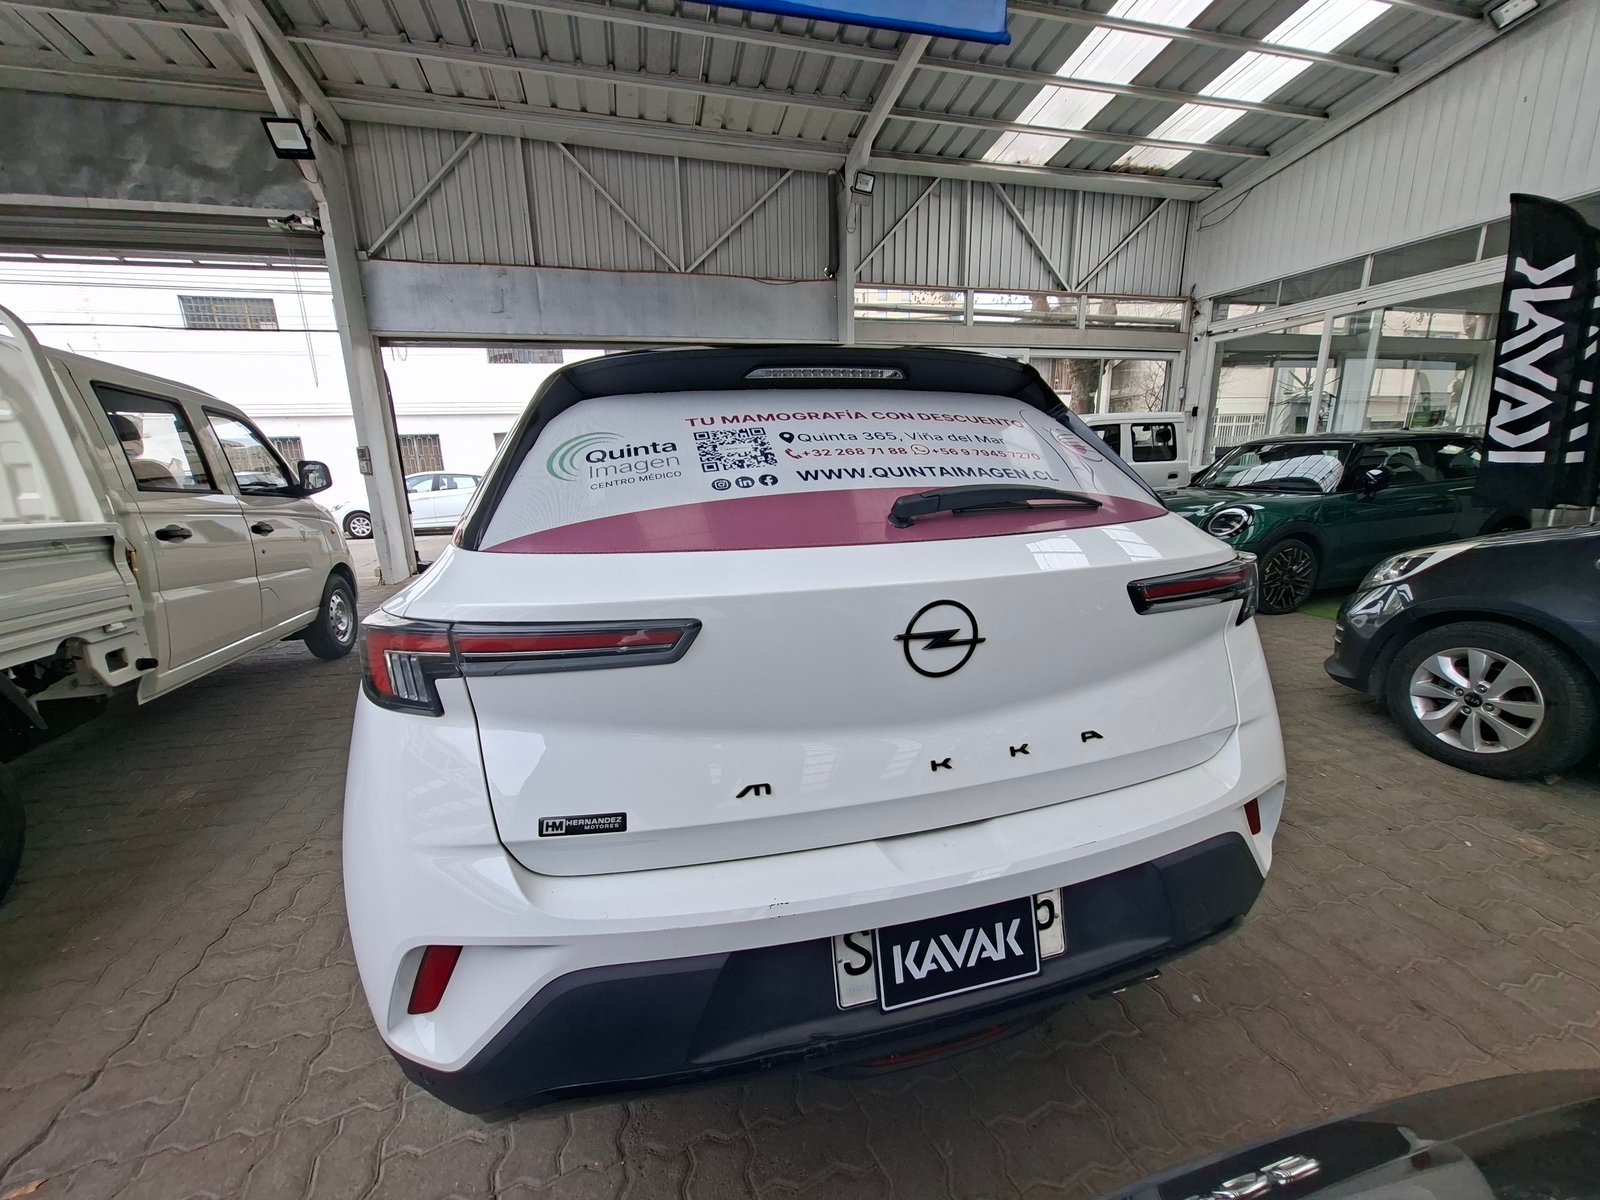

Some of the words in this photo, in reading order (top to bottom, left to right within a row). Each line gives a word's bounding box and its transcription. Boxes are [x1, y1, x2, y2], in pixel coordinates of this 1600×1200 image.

[685, 416, 716, 427] TU
[720, 409, 869, 425] MAMOGRAFÍA
[871, 411, 916, 421] CON
[916, 412, 1024, 428] DESCUENTO
[797, 432, 858, 443] Quinta
[862, 431, 903, 442] 365,
[904, 431, 944, 442] Viña
[948, 433, 973, 443] del
[974, 435, 1006, 445] Mar
[585, 442, 678, 463] Quinta
[802, 448, 832, 457] +32
[835, 447, 866, 456] 268
[867, 447, 885, 455] 71
[888, 447, 908, 455] 88
[932, 447, 959, 456] +56
[961, 448, 971, 456] 9
[972, 449, 1008, 458] 7945
[1008, 451, 1041, 461] 7270
[589, 456, 681, 479] Imagen
[795, 466, 1060, 482] WWW.QUINTAIMAGEN.CL
[590, 477, 636, 490] CENTRO
[638, 470, 682, 482] MÉDICO
[544, 820, 565, 833] HM
[566, 816, 623, 827] HERNANDEZ
[583, 823, 620, 831] MOTORES
[892, 918, 1025, 985] KAVAK
